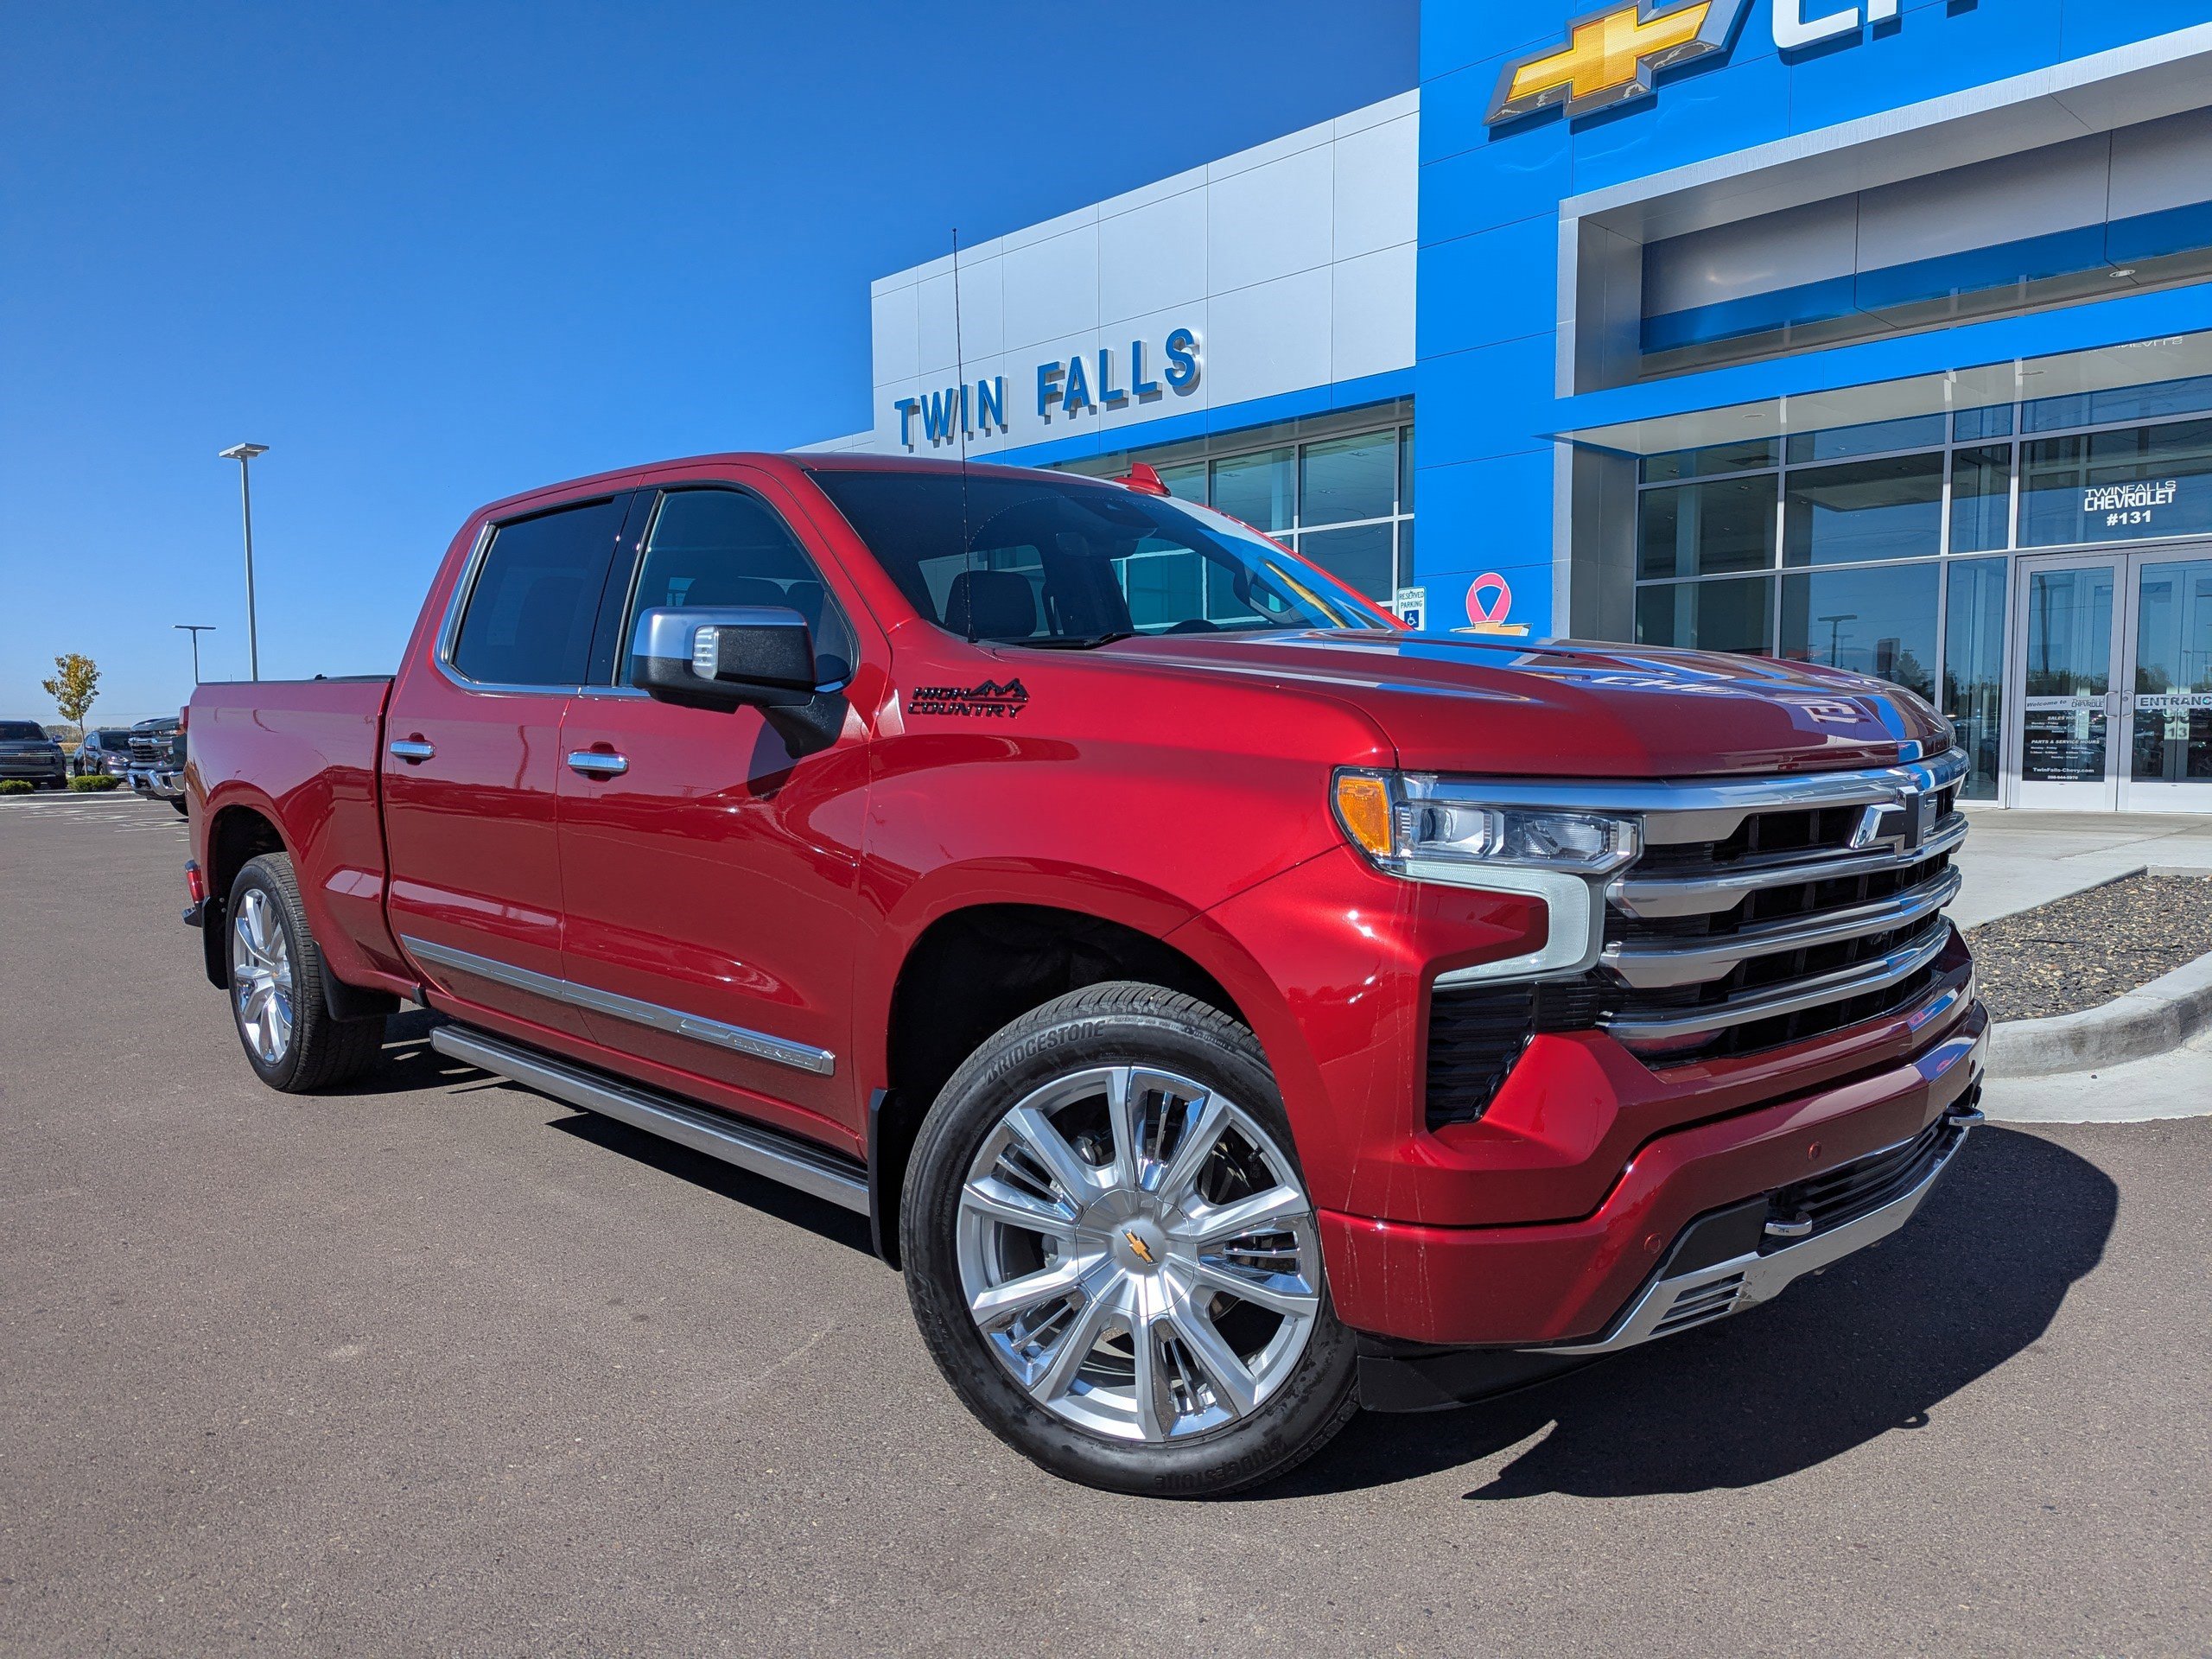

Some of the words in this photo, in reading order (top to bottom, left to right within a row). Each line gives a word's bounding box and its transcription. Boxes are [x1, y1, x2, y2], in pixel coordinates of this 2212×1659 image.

[894, 376, 1007, 446] TWIN
[1037, 327, 1199, 418] FALLS
[2085, 480, 2176, 498] TWINFALLS
[2084, 489, 2176, 512] CHEVROLET
[2107, 510, 2151, 526] #131
[912, 687, 971, 701] HIGH
[907, 702, 1026, 718] COUNTRY
[984, 1020, 1106, 1085] BRIDGESTONE
